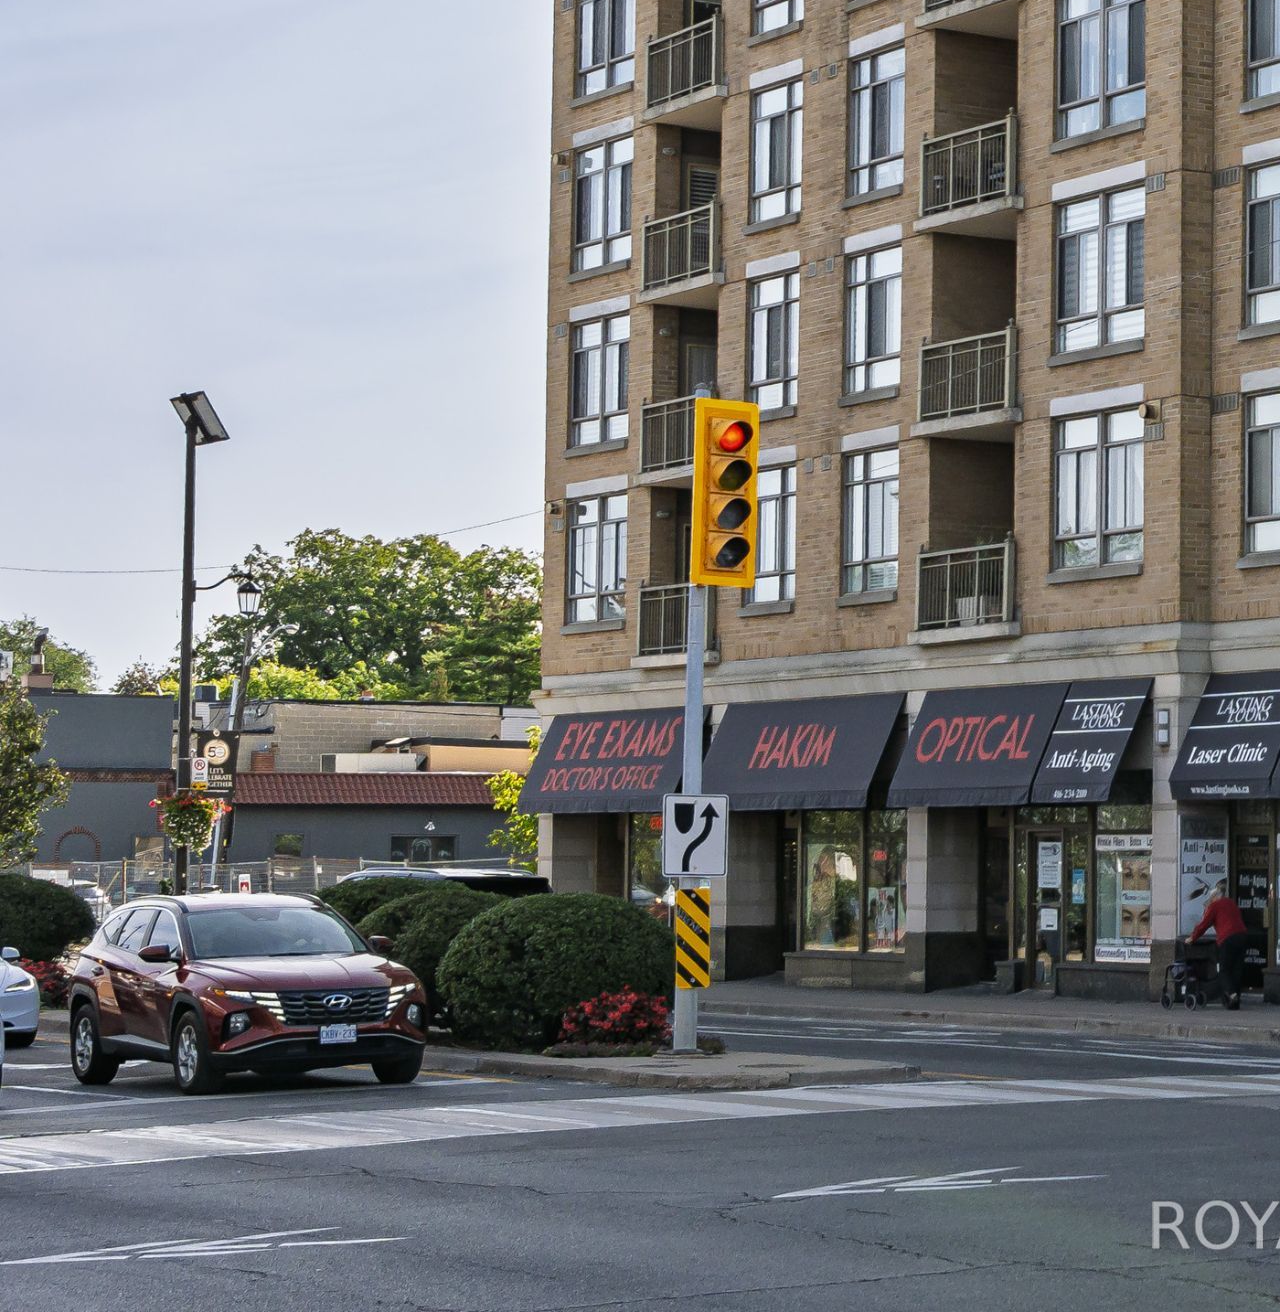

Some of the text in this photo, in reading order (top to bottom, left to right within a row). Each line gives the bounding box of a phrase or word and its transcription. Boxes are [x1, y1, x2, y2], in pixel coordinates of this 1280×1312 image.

[1072, 702, 1126, 720] LASTING
[1217, 696, 1274, 715] LASTING
[1227, 709, 1270, 723] LOOKS
[555, 715, 683, 761] EYE EXAMS
[748, 723, 838, 769] HAKIM
[915, 714, 1035, 764] OPTICAL
[1045, 748, 1116, 773] Anti-Aging
[1187, 742, 1267, 765] Laser Clinic
[611, 764, 663, 790] OFFICE
[1184, 841, 1225, 854] Anti-Aging
[1182, 863, 1226, 874] Laser Clinic
[1239, 874, 1267, 888] Anti-Aging
